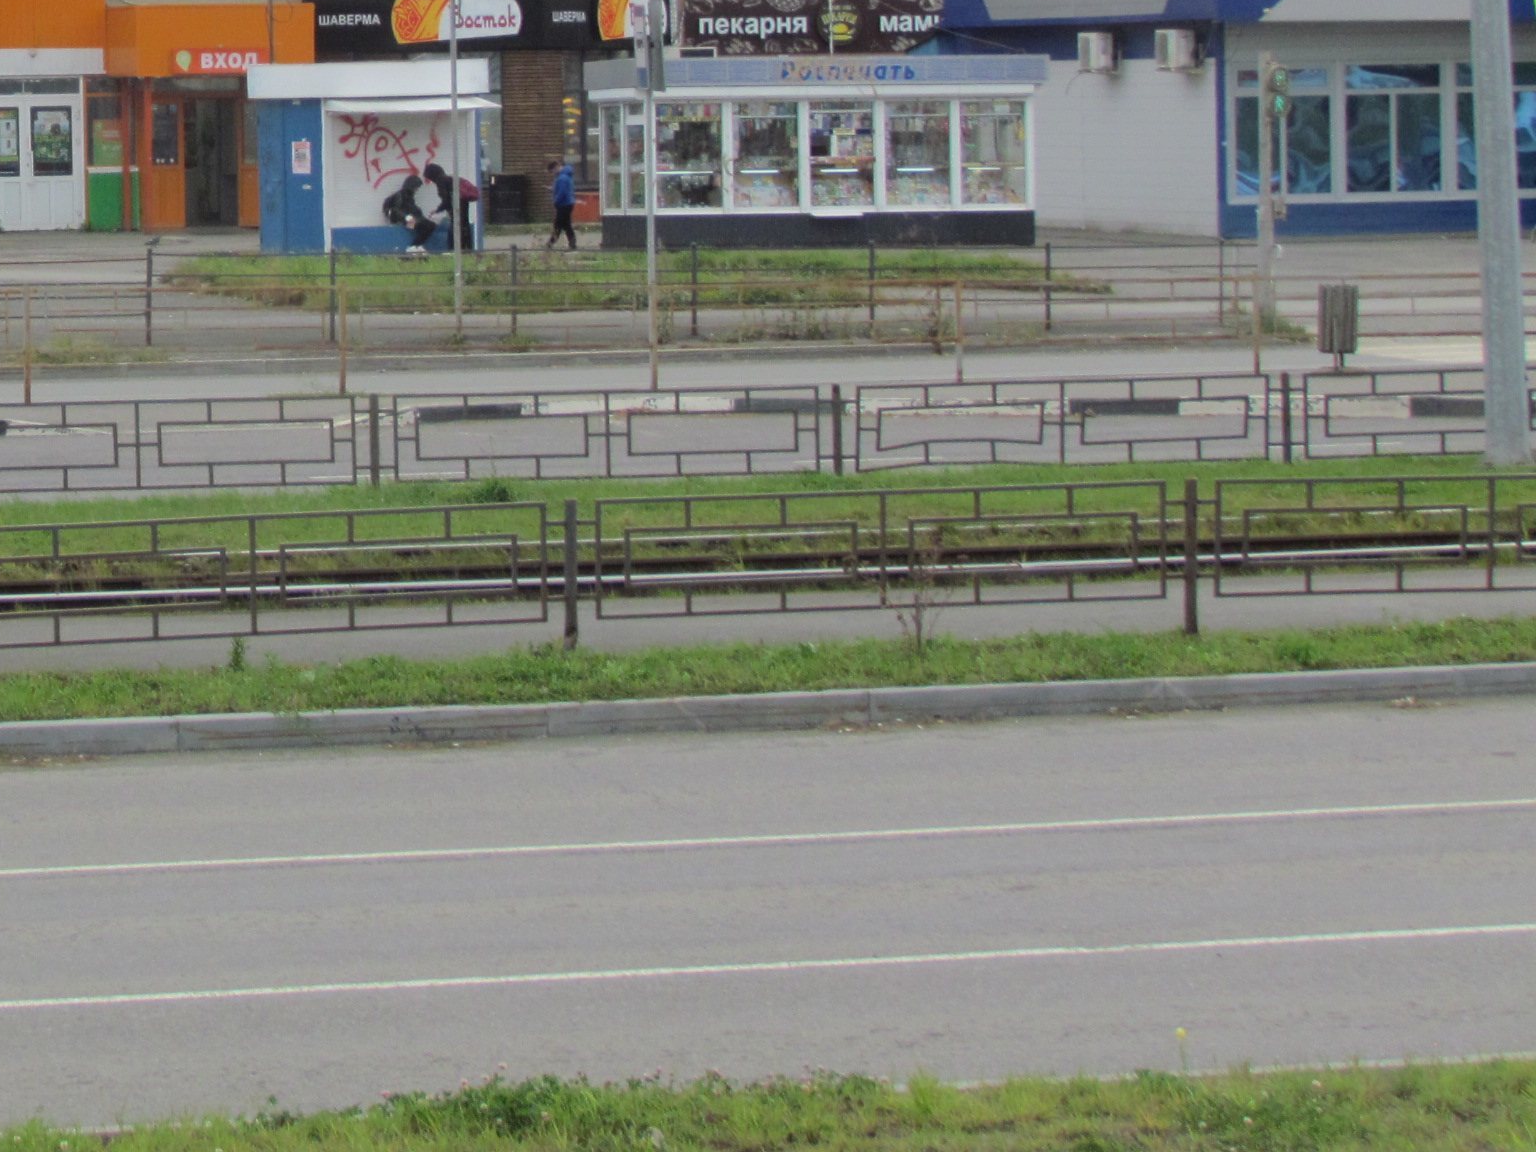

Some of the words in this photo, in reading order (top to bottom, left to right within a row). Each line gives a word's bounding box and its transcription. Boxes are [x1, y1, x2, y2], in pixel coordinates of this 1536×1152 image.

[318, 14, 381, 26] ШАВЕРМА
[552, 10, 586, 23] ШАВЕРМА
[698, 15, 808, 40] пекарня
[200, 52, 258, 71] ВХОД
